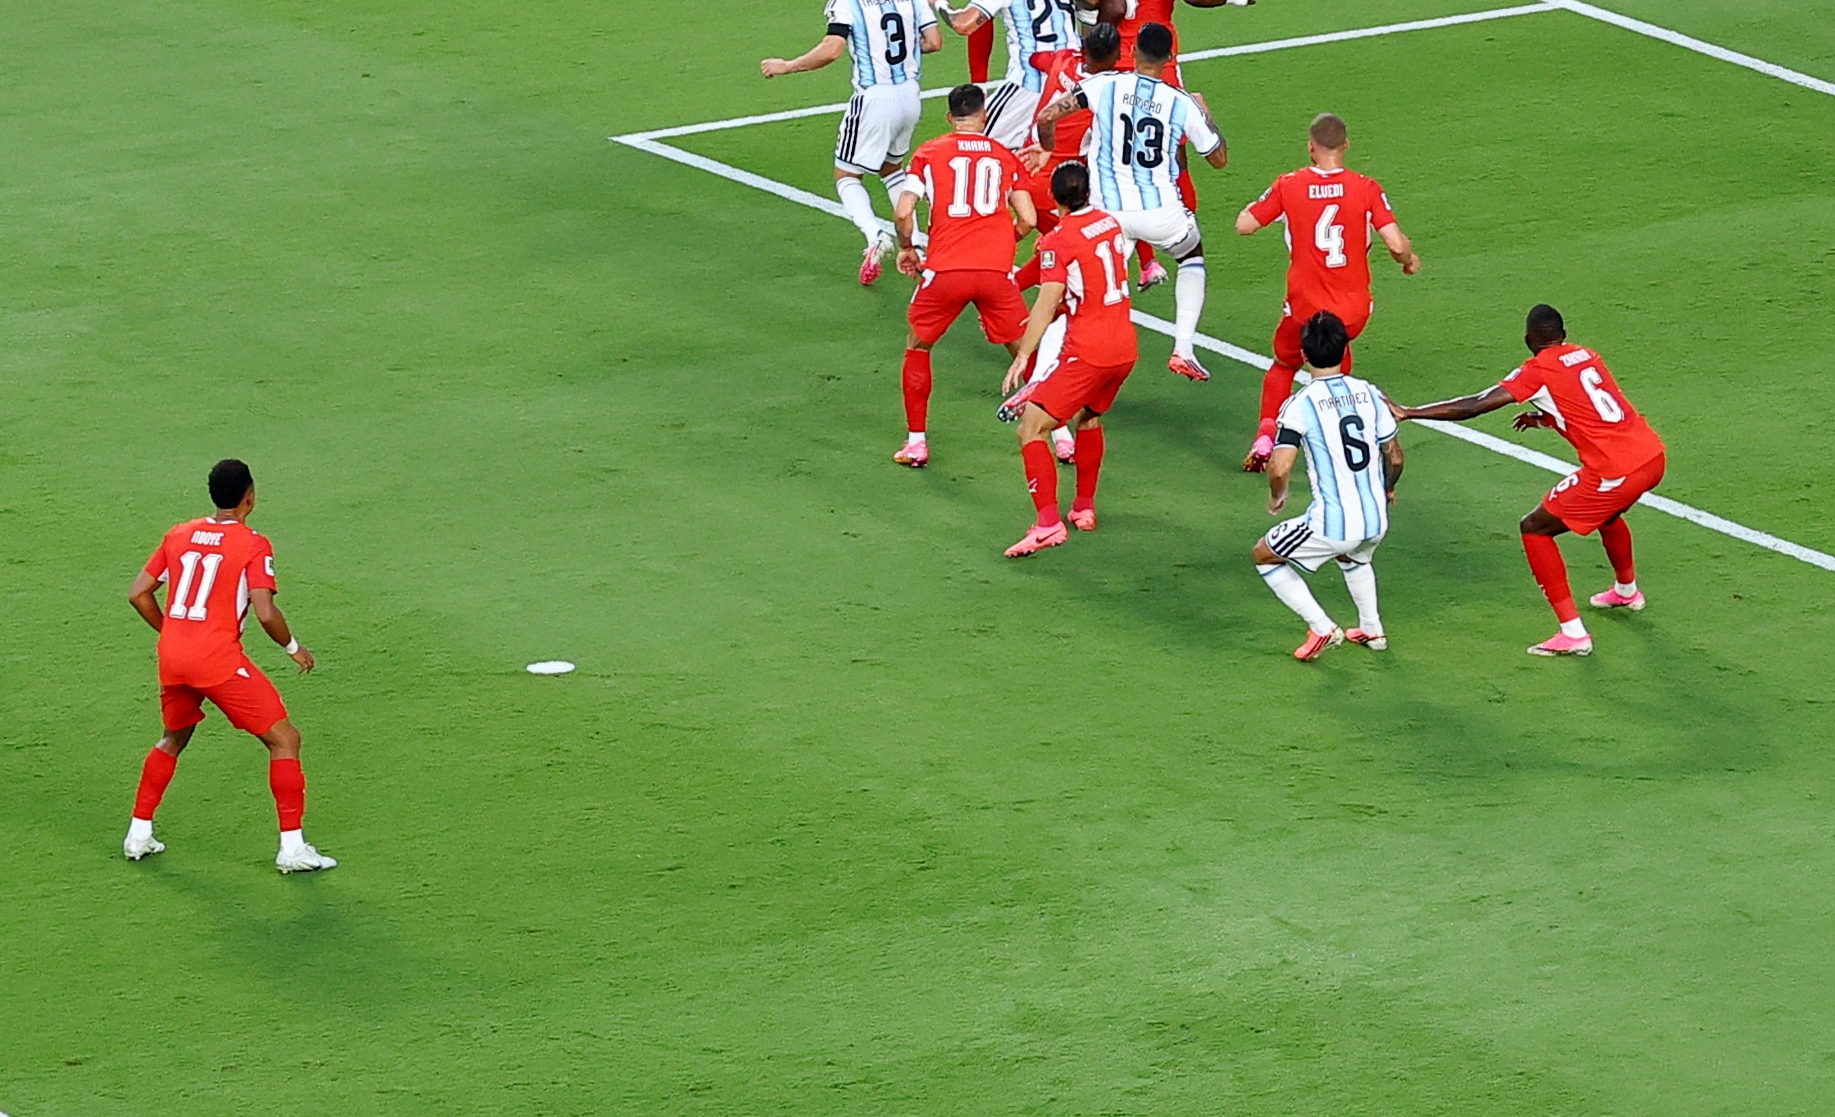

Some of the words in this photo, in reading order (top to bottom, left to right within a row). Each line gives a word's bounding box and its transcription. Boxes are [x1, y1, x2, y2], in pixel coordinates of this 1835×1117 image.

[880, 12, 908, 66] 3
[1120, 112, 1165, 169] 13
[947, 156, 1002, 218] 10
[1314, 203, 1347, 269] 4
[1579, 366, 1626, 424] 6
[1338, 414, 1371, 473] 6
[168, 550, 224, 621] 11
